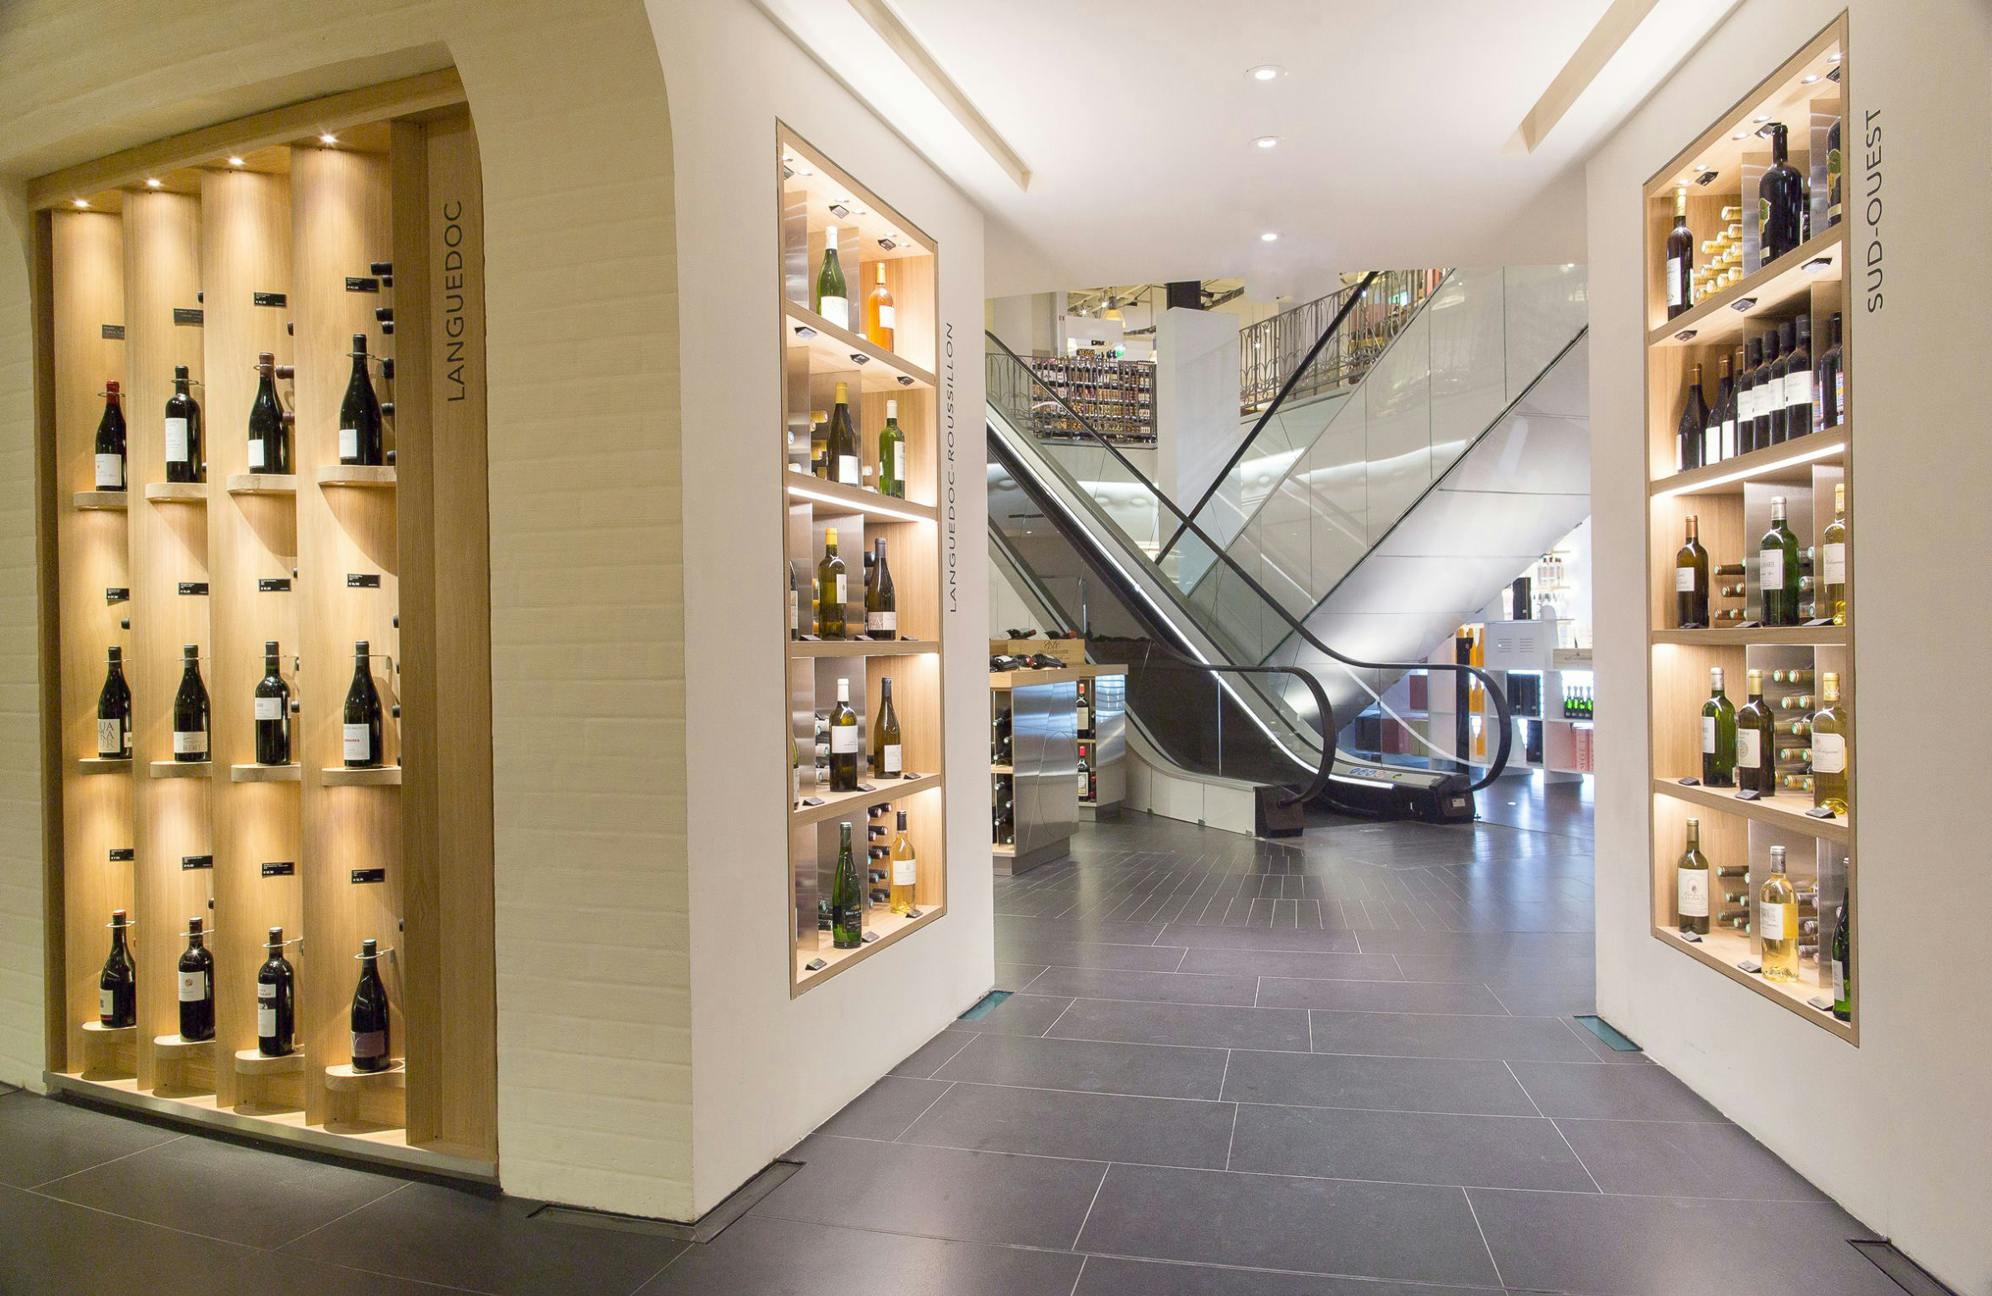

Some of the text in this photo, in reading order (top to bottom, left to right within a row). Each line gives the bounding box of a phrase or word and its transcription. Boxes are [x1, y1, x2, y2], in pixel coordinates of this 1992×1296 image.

[443, 200, 465, 402] LANGUEDOC
[1865, 109, 1884, 313] SUD-OUEST
[946, 323, 957, 613] LANGUEDOC-ROUSSILLON
